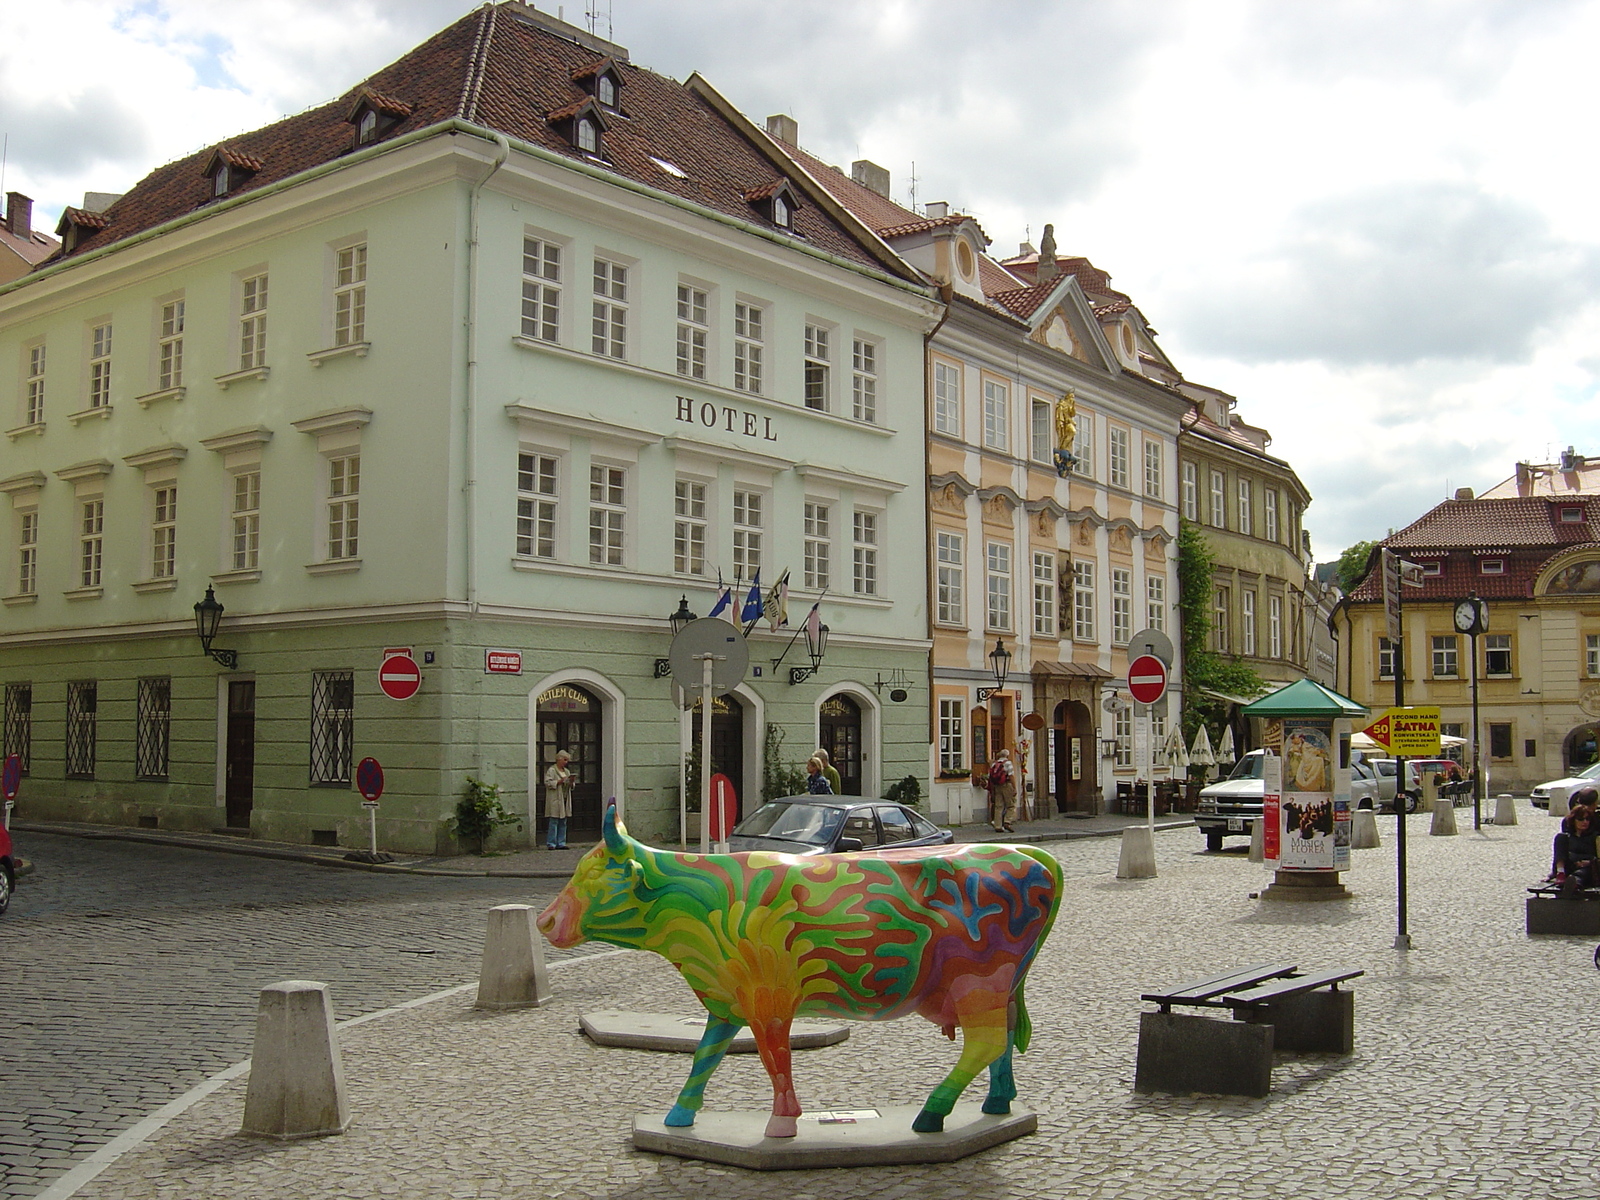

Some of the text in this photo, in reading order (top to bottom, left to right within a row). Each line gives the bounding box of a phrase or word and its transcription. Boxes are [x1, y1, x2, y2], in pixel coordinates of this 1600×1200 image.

[676, 395, 777, 441] HOTEL
[538, 687, 588, 705] BETLEM CLUB
[1373, 724, 1389, 734] 50
[1394, 720, 1437, 732] ŠATNA
[1290, 838, 1325, 847] MUSICA
[1291, 846, 1325, 854] FLOREA
